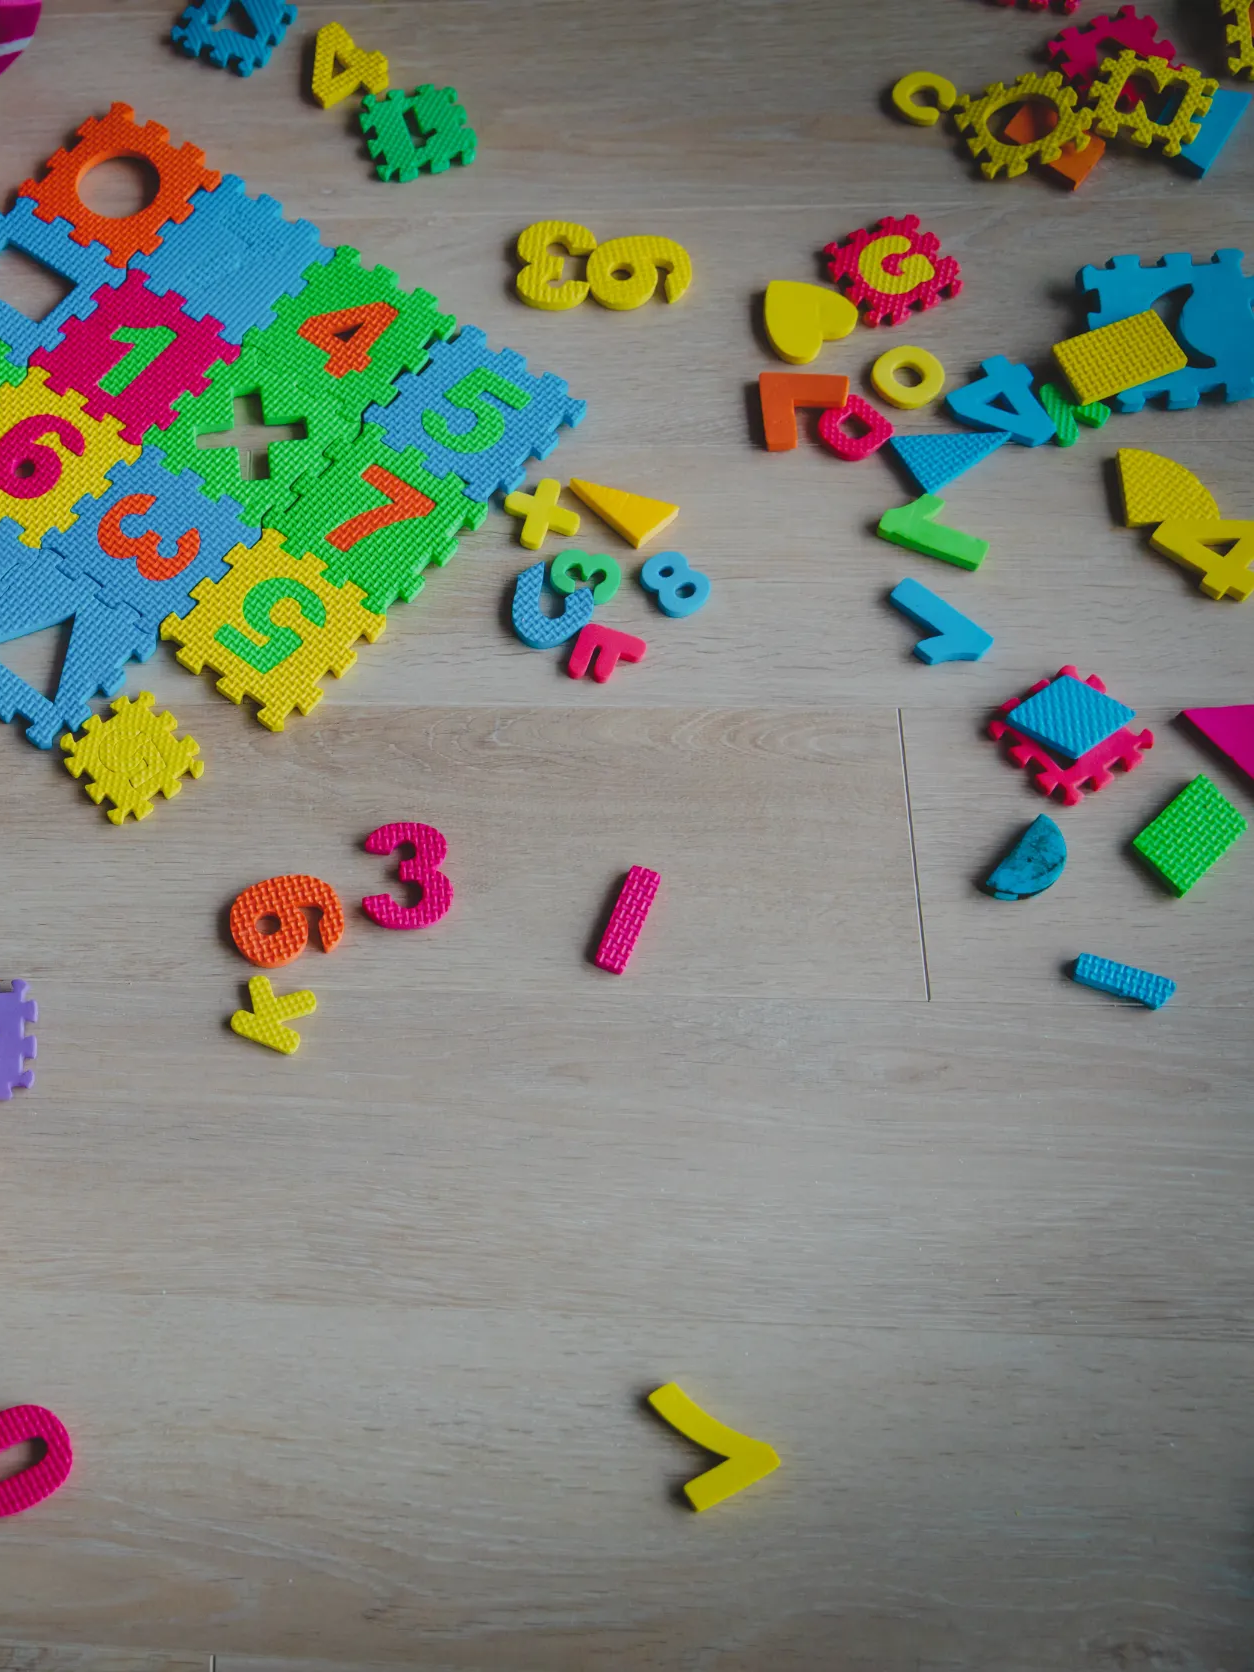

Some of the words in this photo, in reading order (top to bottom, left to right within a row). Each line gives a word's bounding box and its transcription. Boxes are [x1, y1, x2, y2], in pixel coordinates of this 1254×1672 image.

[312, 22, 390, 110] 4
[892, 71, 957, 127] C
[516, 220, 598, 311] 3
[98, 326, 178, 397] 1
[297, 302, 399, 379] 4
[421, 367, 532, 454] 5
[97, 493, 202, 582] 3
[325, 464, 436, 552] 7
[214, 577, 327, 674] 5
[639, 551, 712, 619] 8
[362, 821, 454, 931] 3
